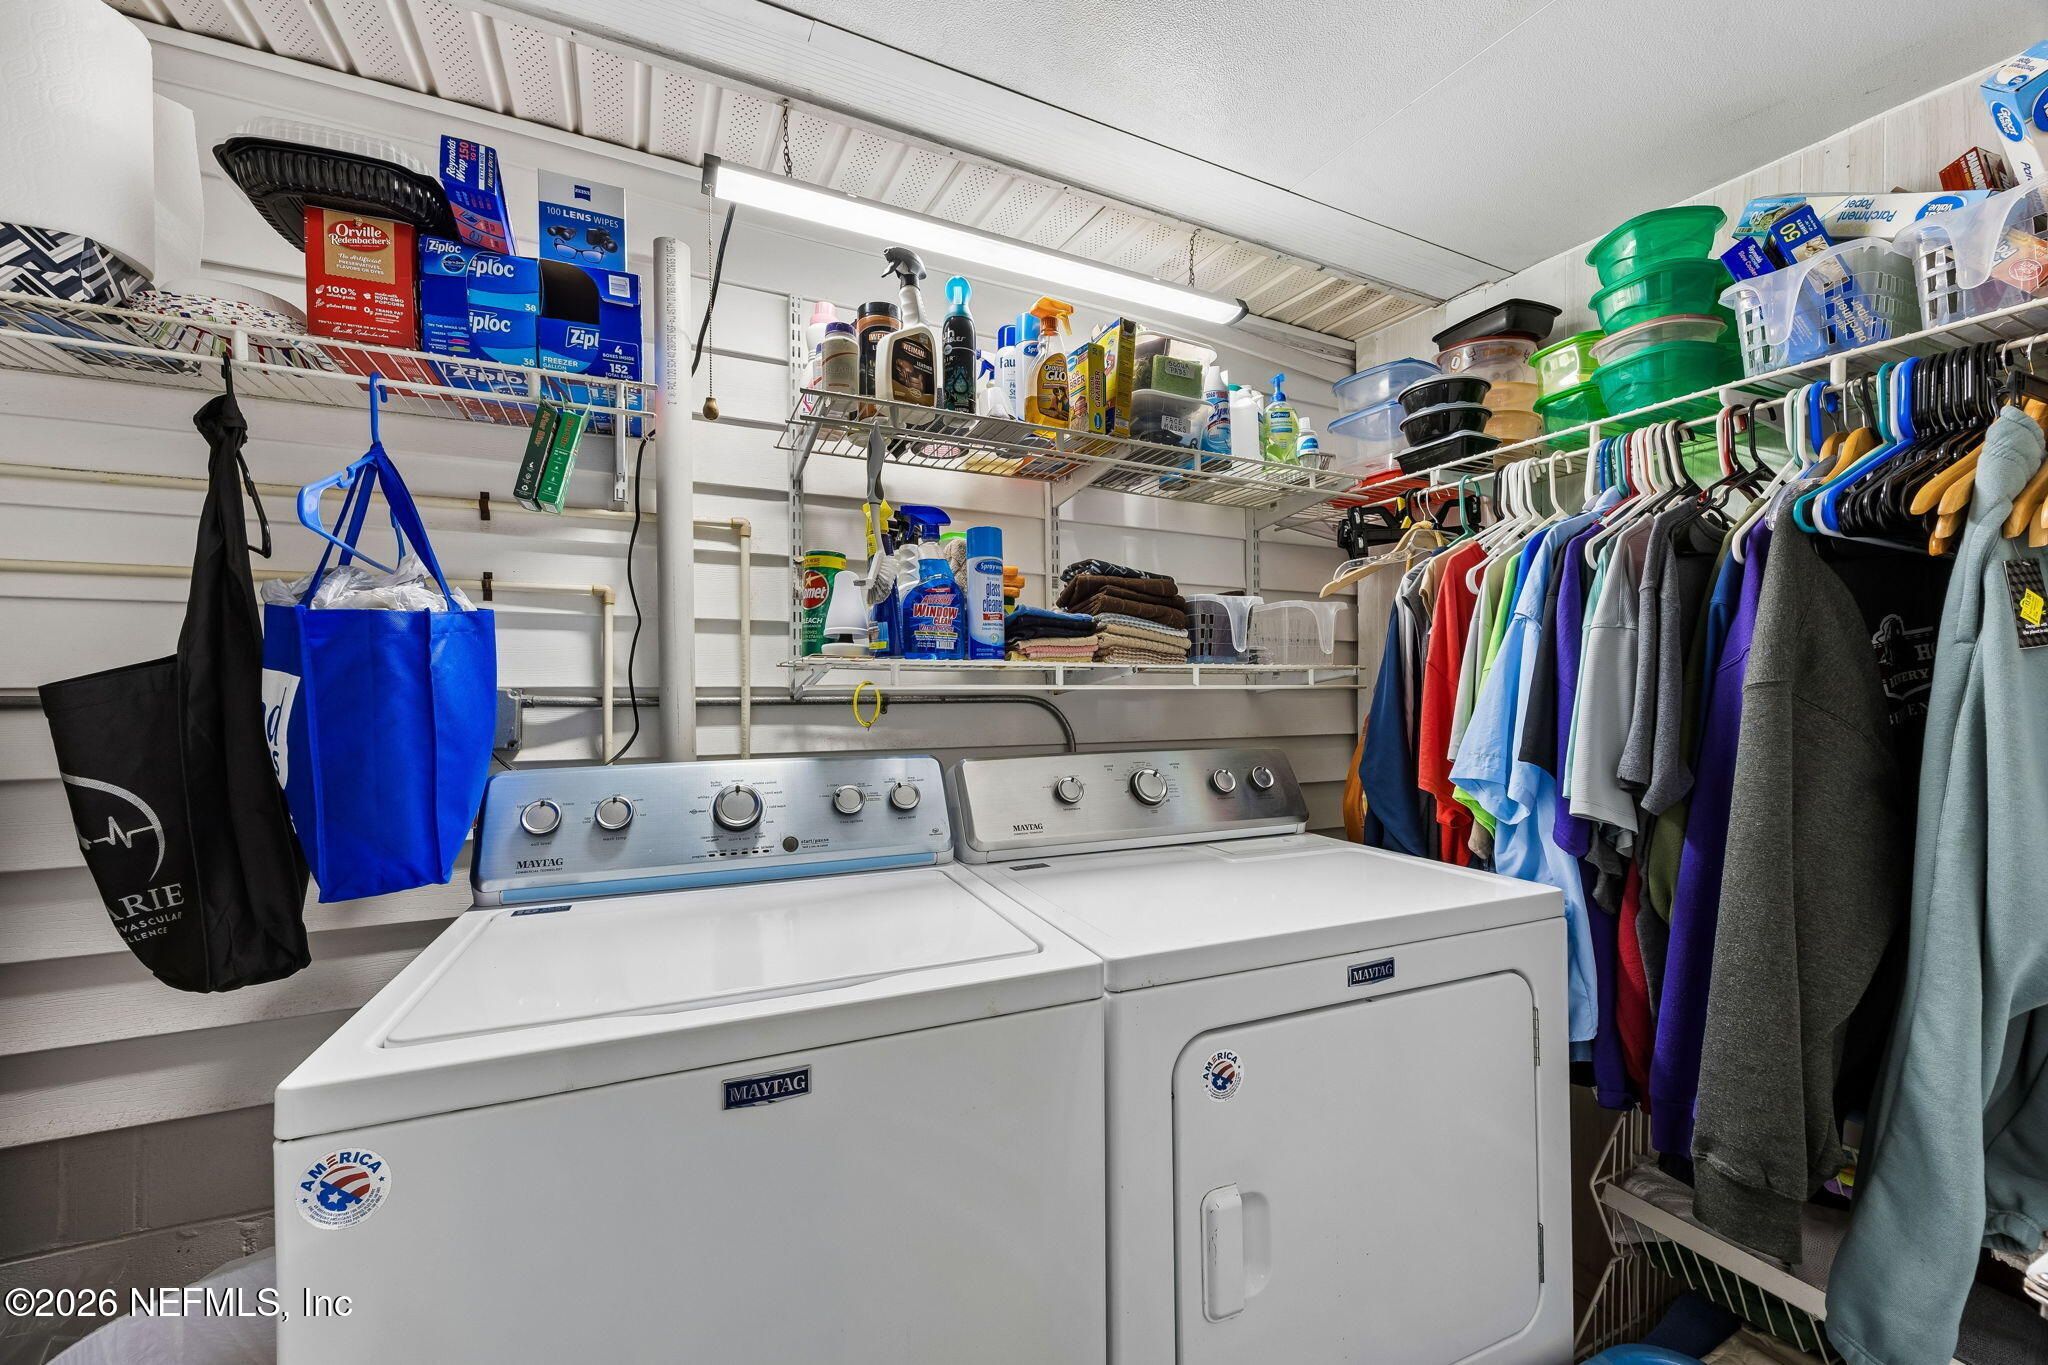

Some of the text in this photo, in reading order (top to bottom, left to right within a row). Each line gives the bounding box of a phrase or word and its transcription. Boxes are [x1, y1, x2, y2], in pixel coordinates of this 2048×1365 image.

[446, 138, 456, 178] Reynolds
[456, 142, 469, 182] Wrap 150
[1966, 151, 1987, 190] DIAMON
[1845, 197, 1875, 210] Paper
[546, 206, 619, 229] 100 LENS WIPES
[1836, 210, 1898, 223] Parchment
[336, 224, 382, 237] Orville
[1780, 223, 1801, 242] 50
[328, 234, 391, 246] Redenbacher's
[429, 240, 462, 254] Ziploc
[1746, 260, 1758, 276] Cooker
[326, 286, 356, 296] 100%
[374, 300, 404, 308] POPCORN
[524, 304, 536, 312] 38
[469, 312, 511, 334] iploc
[570, 329, 600, 350] Zipl
[614, 346, 622, 356] 4
[902, 343, 927, 359] WEIMAN
[524, 358, 535, 366] 38
[542, 356, 578, 368] FREEZER
[542, 362, 567, 370] GALLON
[449, 366, 528, 385] Ziplo
[610, 364, 628, 375] 152
[1046, 371, 1067, 381] GLO
[1169, 366, 1187, 376] PADS
[803, 586, 826, 599] omet
[986, 581, 1000, 598] glass
[913, 603, 958, 619] WINDOW
[1013, 822, 1044, 832] MAYTAG
[516, 858, 564, 870] MAYTAG
[1353, 964, 1392, 982] MAYTAG
[1202, 1052, 1238, 1080] AMERICA
[729, 1075, 806, 1103] MAYTAG
[300, 1152, 382, 1192] AMERICA
